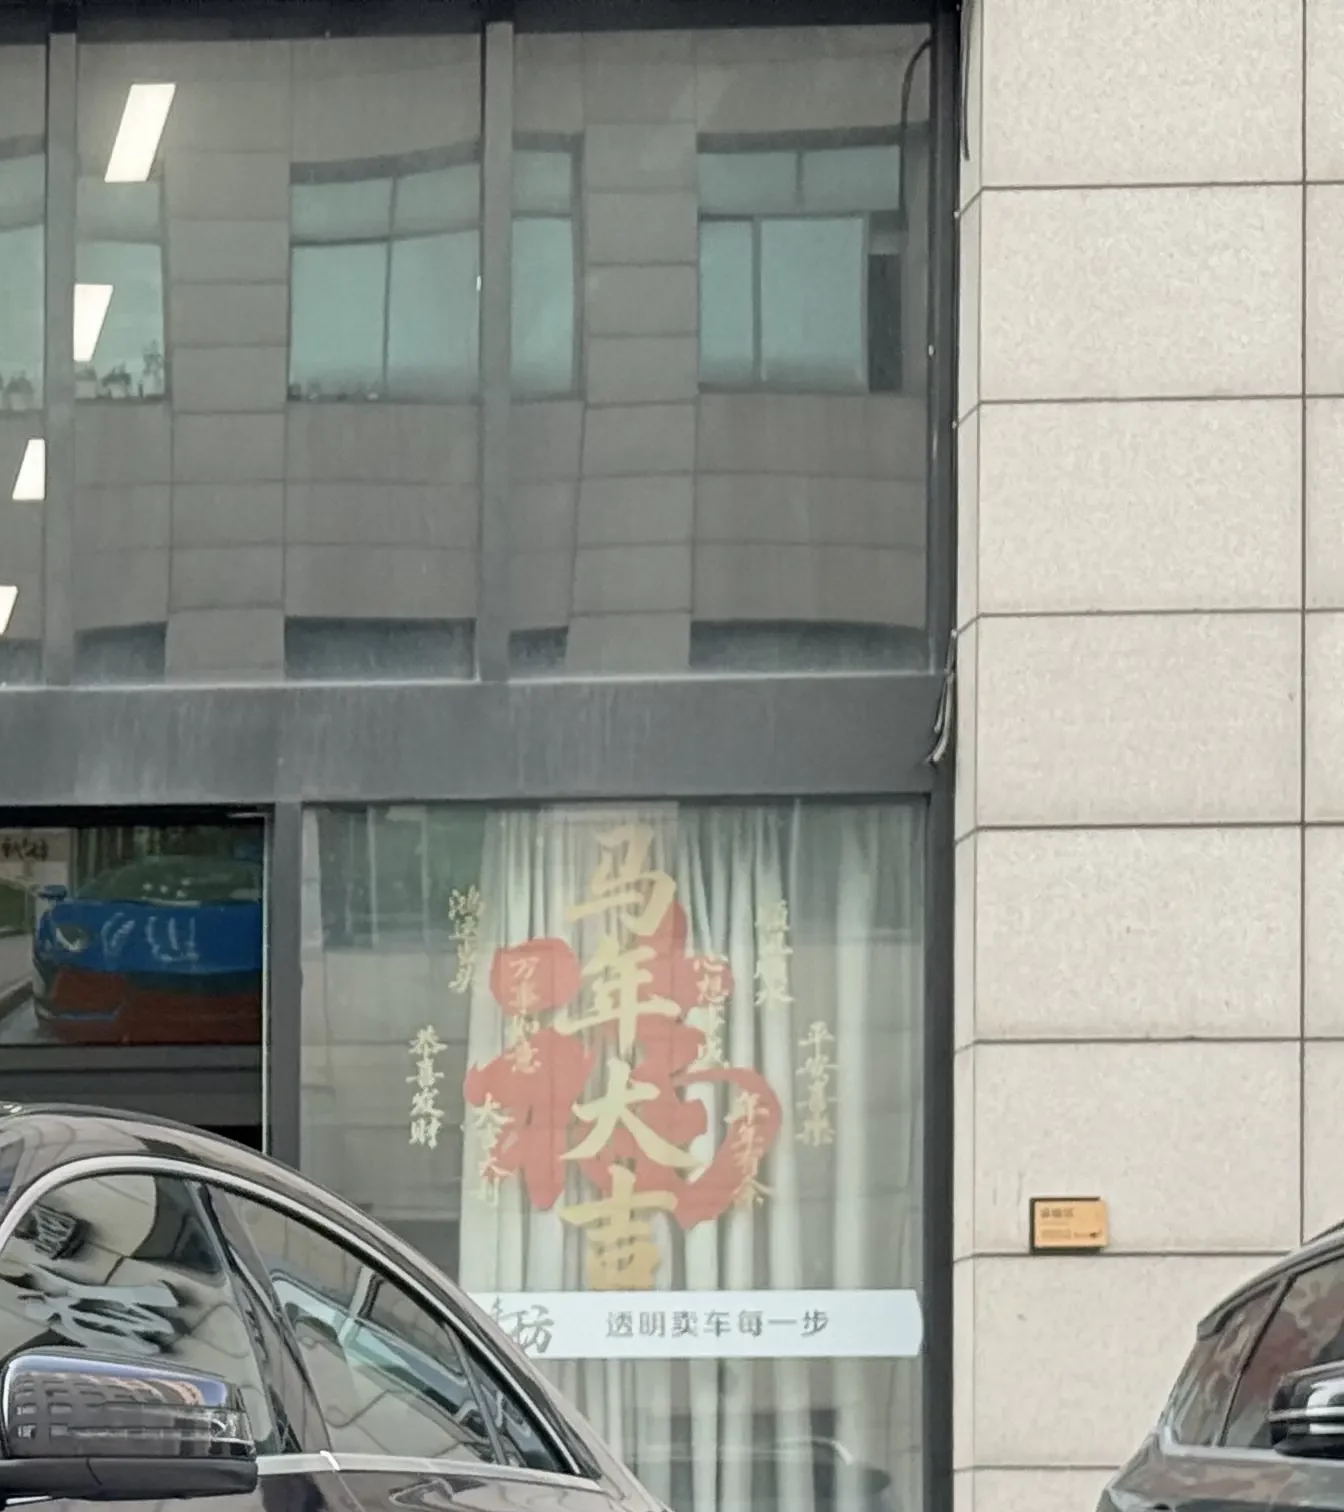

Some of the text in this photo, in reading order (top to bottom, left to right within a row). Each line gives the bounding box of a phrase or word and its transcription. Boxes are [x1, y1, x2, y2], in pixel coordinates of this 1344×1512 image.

[605, 1309, 830, 1338] 透明卖车每一步
